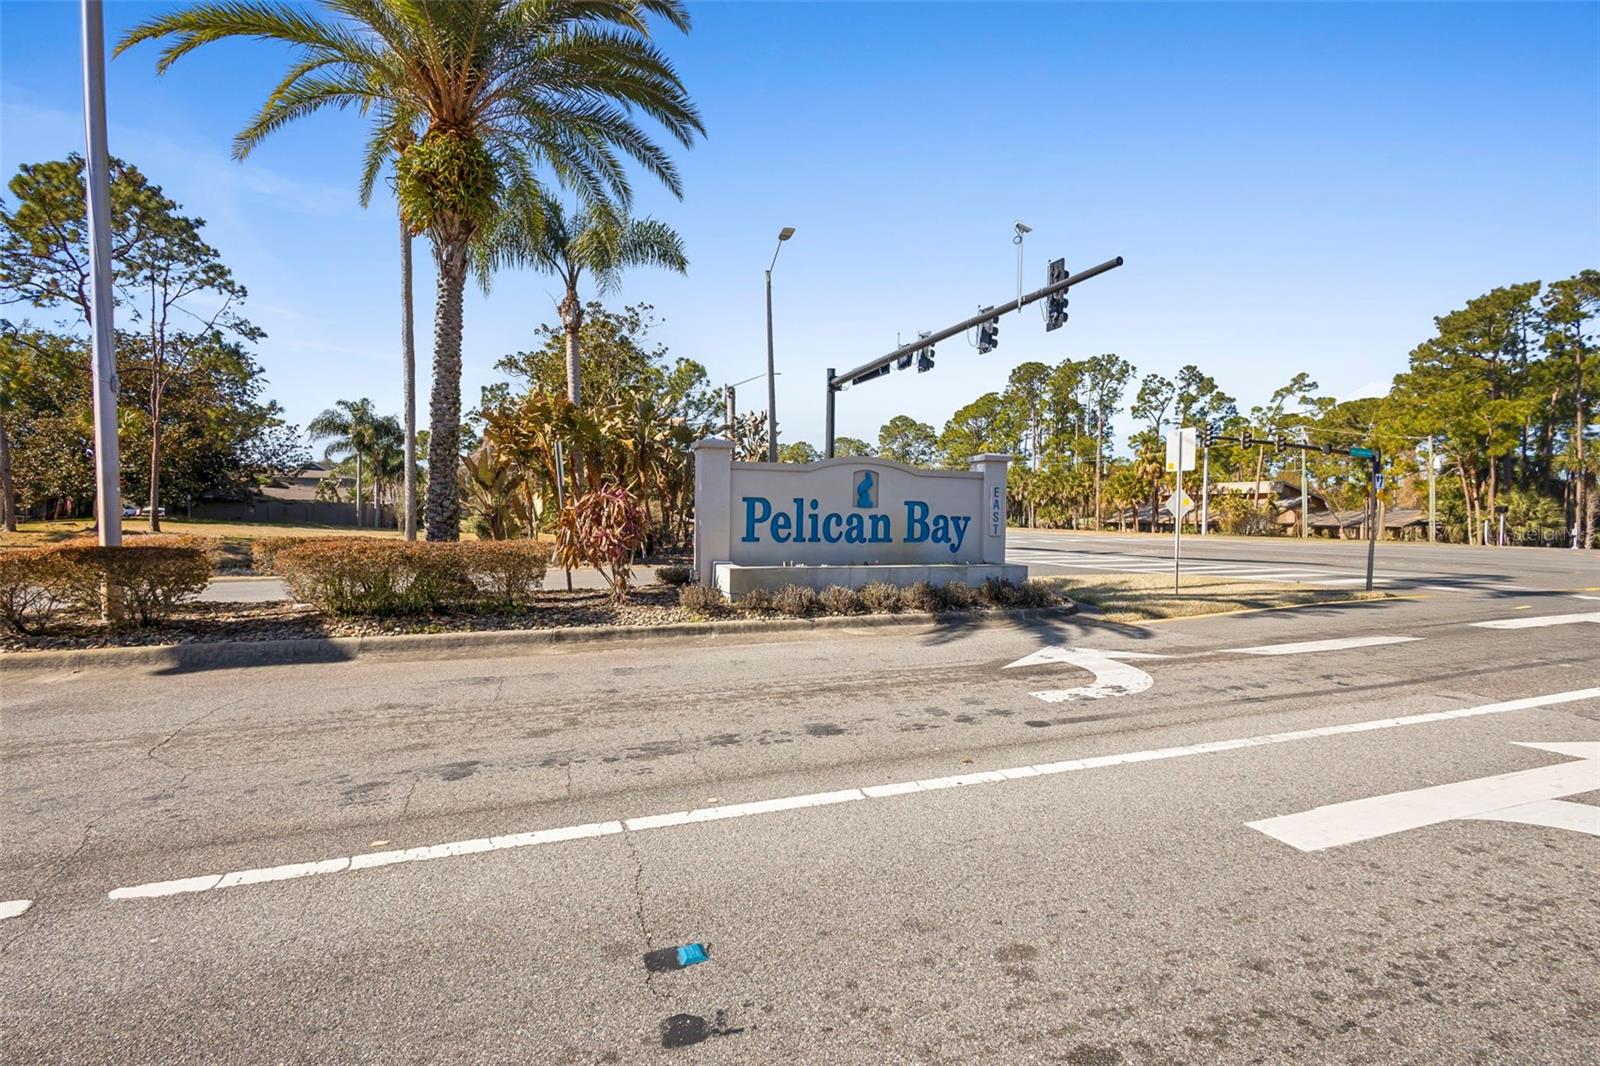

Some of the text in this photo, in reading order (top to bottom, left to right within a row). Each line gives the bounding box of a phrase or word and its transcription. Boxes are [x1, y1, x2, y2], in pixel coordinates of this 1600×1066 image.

[741, 496, 971, 553] Pelican Bay
[992, 487, 1000, 535] EAST
